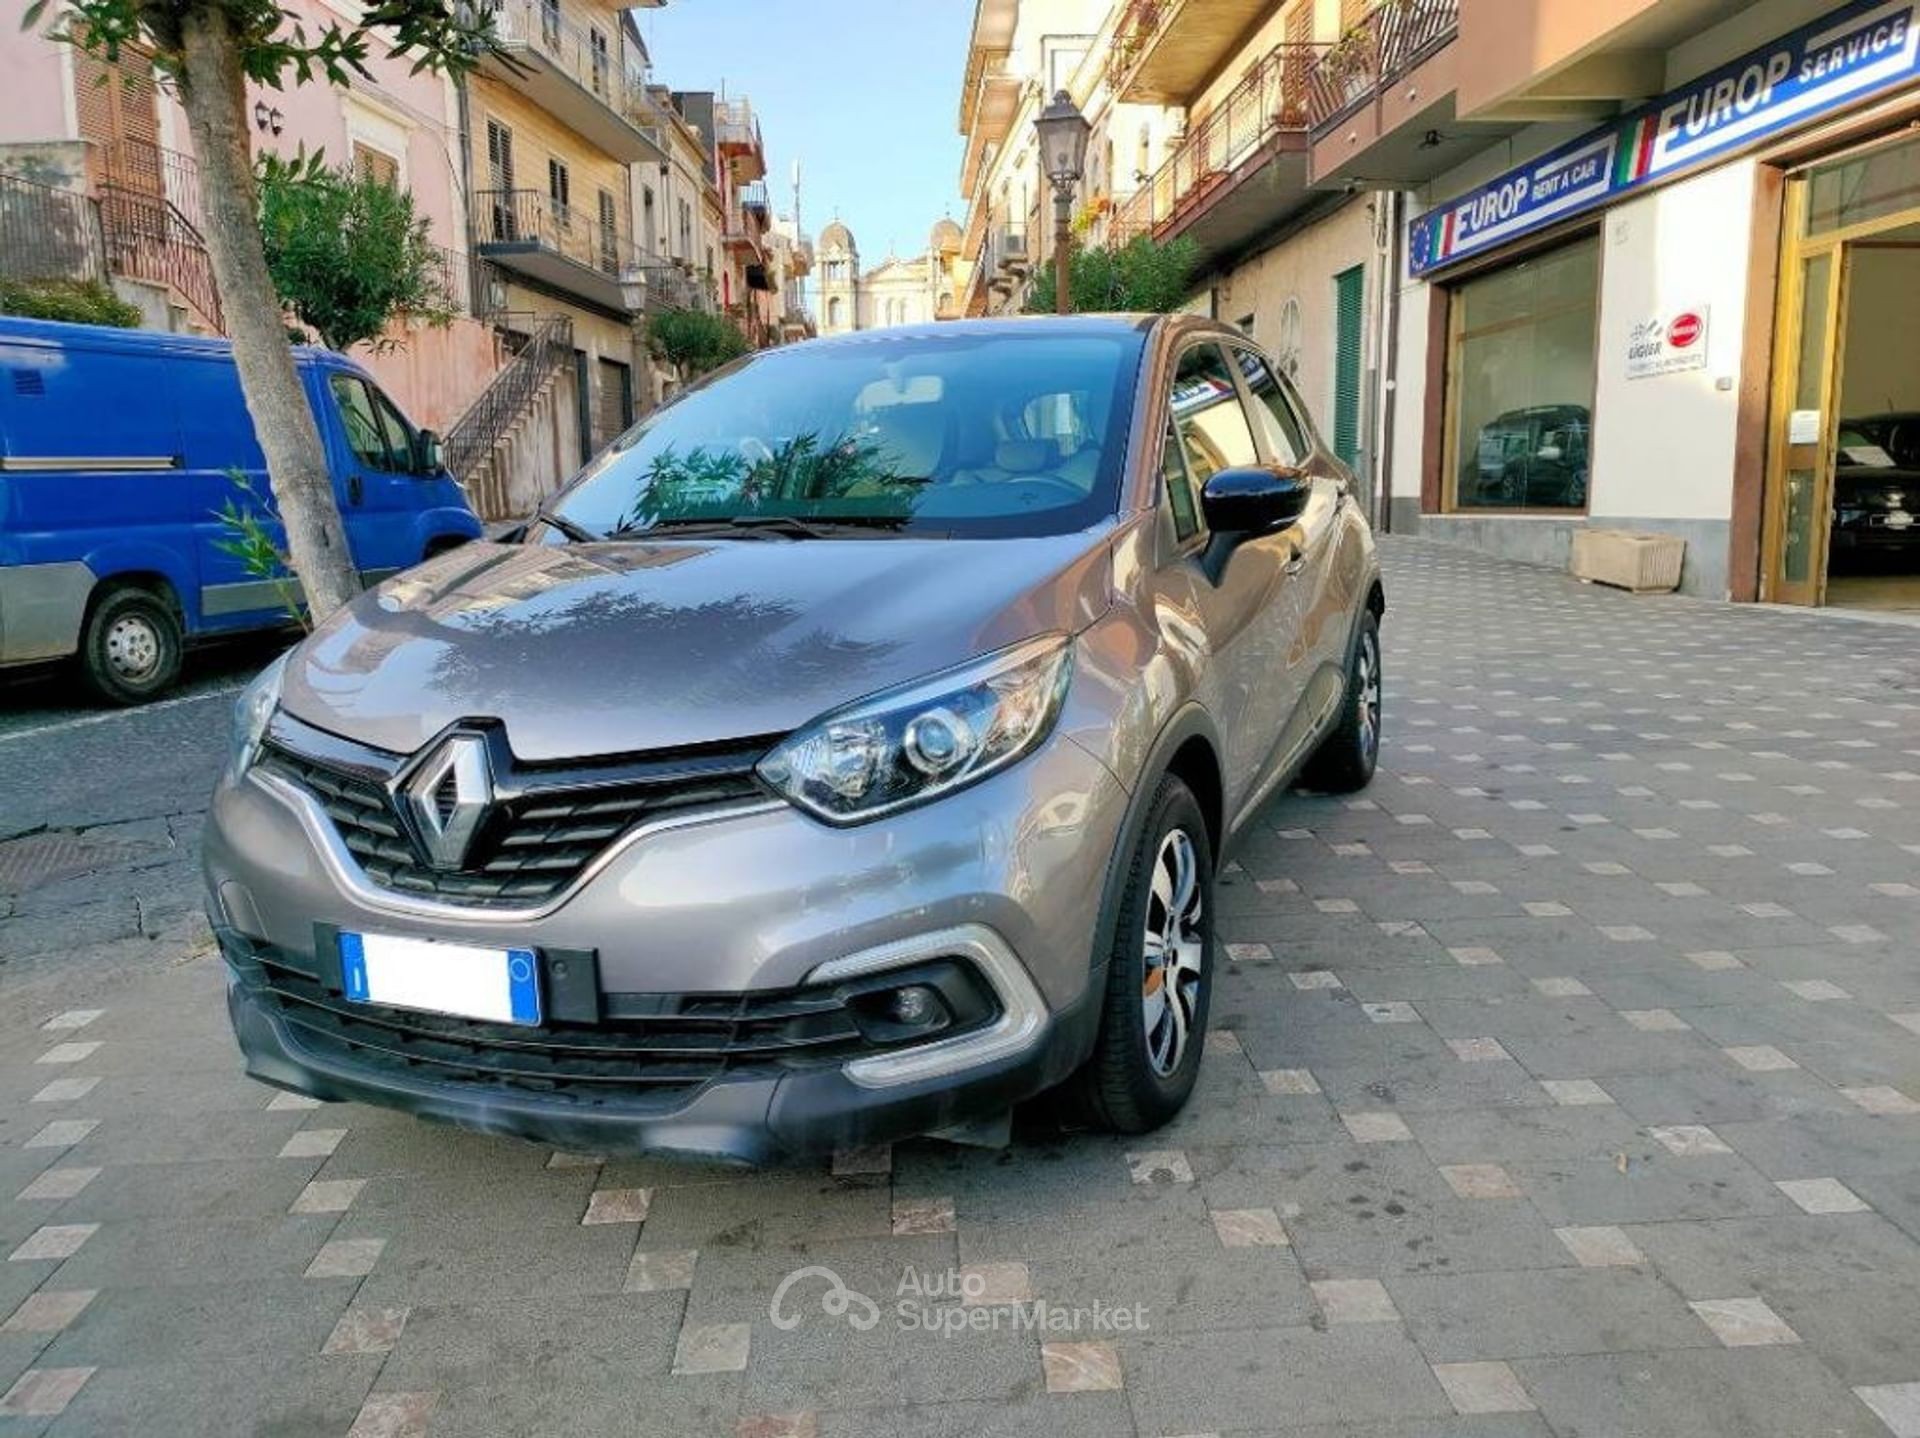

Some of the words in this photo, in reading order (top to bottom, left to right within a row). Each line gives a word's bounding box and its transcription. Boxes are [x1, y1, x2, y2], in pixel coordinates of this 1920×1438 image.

[1651, 51, 1792, 164] EUROP
[1798, 18, 1907, 84] SERVICE
[1453, 176, 1530, 243] EUROP
[1531, 175, 1560, 202] RENT
[1560, 171, 1570, 190] A
[1571, 159, 1597, 185] CAR
